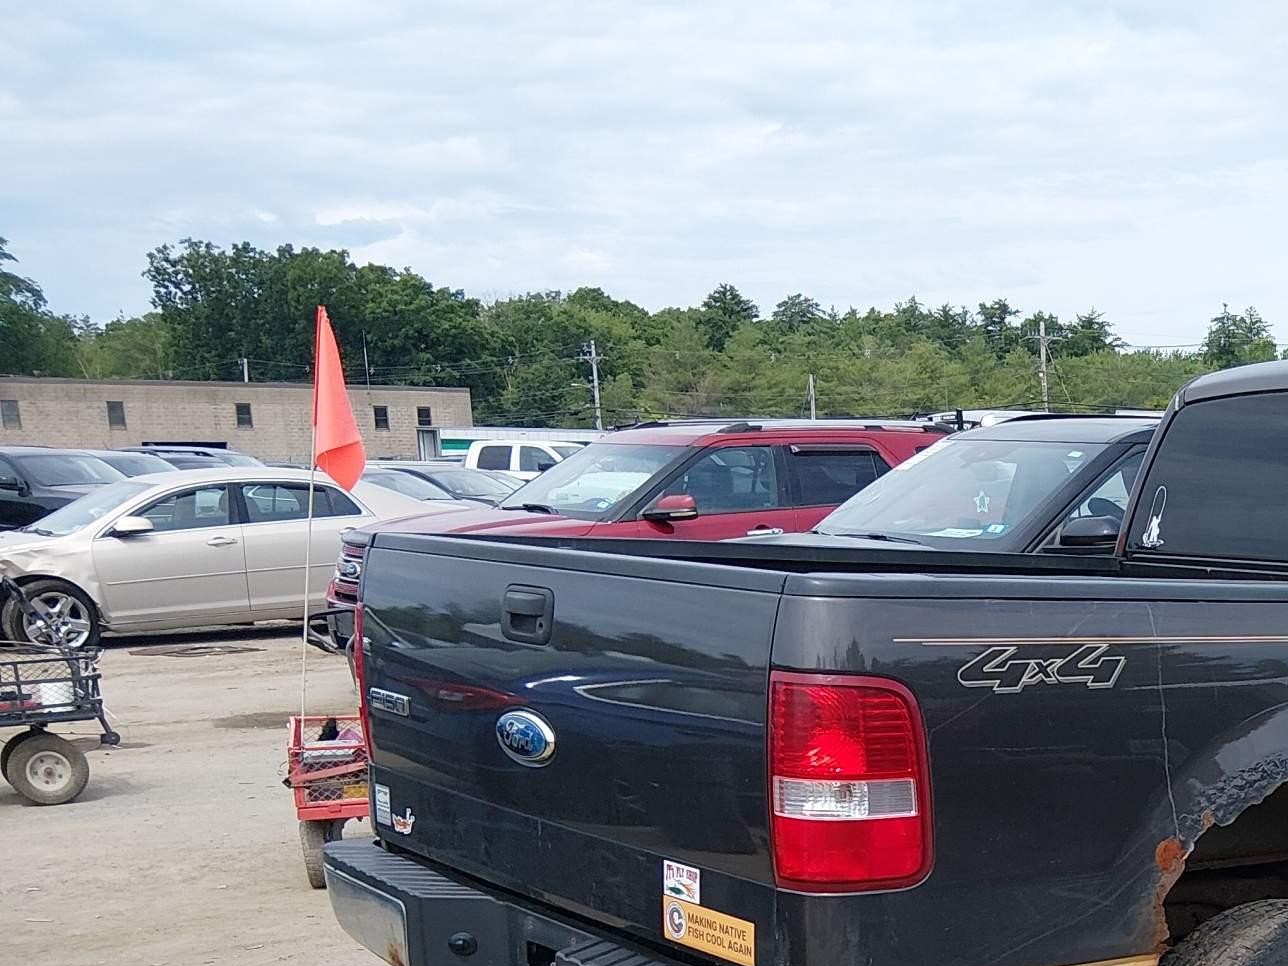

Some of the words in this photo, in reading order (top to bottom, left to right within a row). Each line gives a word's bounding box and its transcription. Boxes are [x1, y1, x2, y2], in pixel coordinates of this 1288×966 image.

[957, 643, 1127, 694] 4x4
[688, 912, 717, 931] MAKING
[719, 922, 747, 941] NATIVE
[688, 926, 704, 941] FISH
[706, 932, 726, 949] COOL
[728, 940, 752, 958] AGAIN
